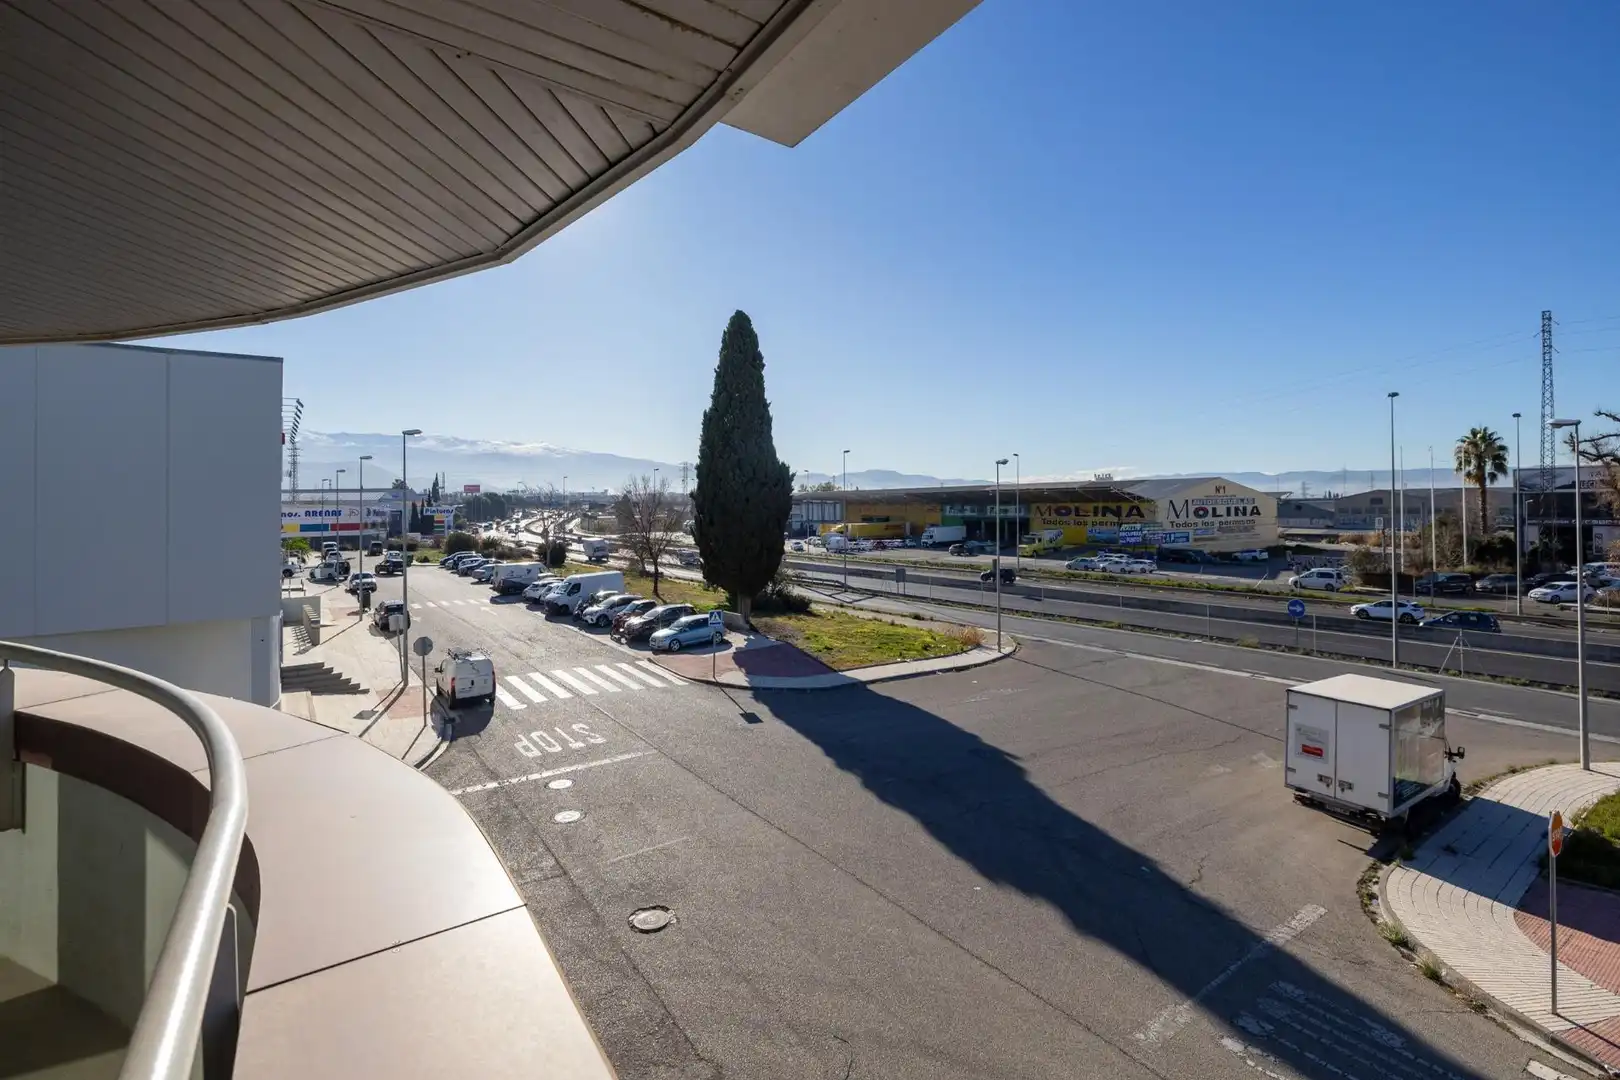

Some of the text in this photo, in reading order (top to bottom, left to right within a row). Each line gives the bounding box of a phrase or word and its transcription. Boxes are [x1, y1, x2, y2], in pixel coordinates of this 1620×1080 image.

[304, 509, 343, 518] ARENAS
[1034, 504, 1145, 518] MOLINA
[1167, 499, 1262, 520] MOLINA
[1042, 518, 1070, 526] Todos
[1072, 519, 1088, 527] los
[1170, 521, 1198, 529] Todos
[1219, 518, 1256, 529] permisos
[514, 723, 606, 758] STOP
